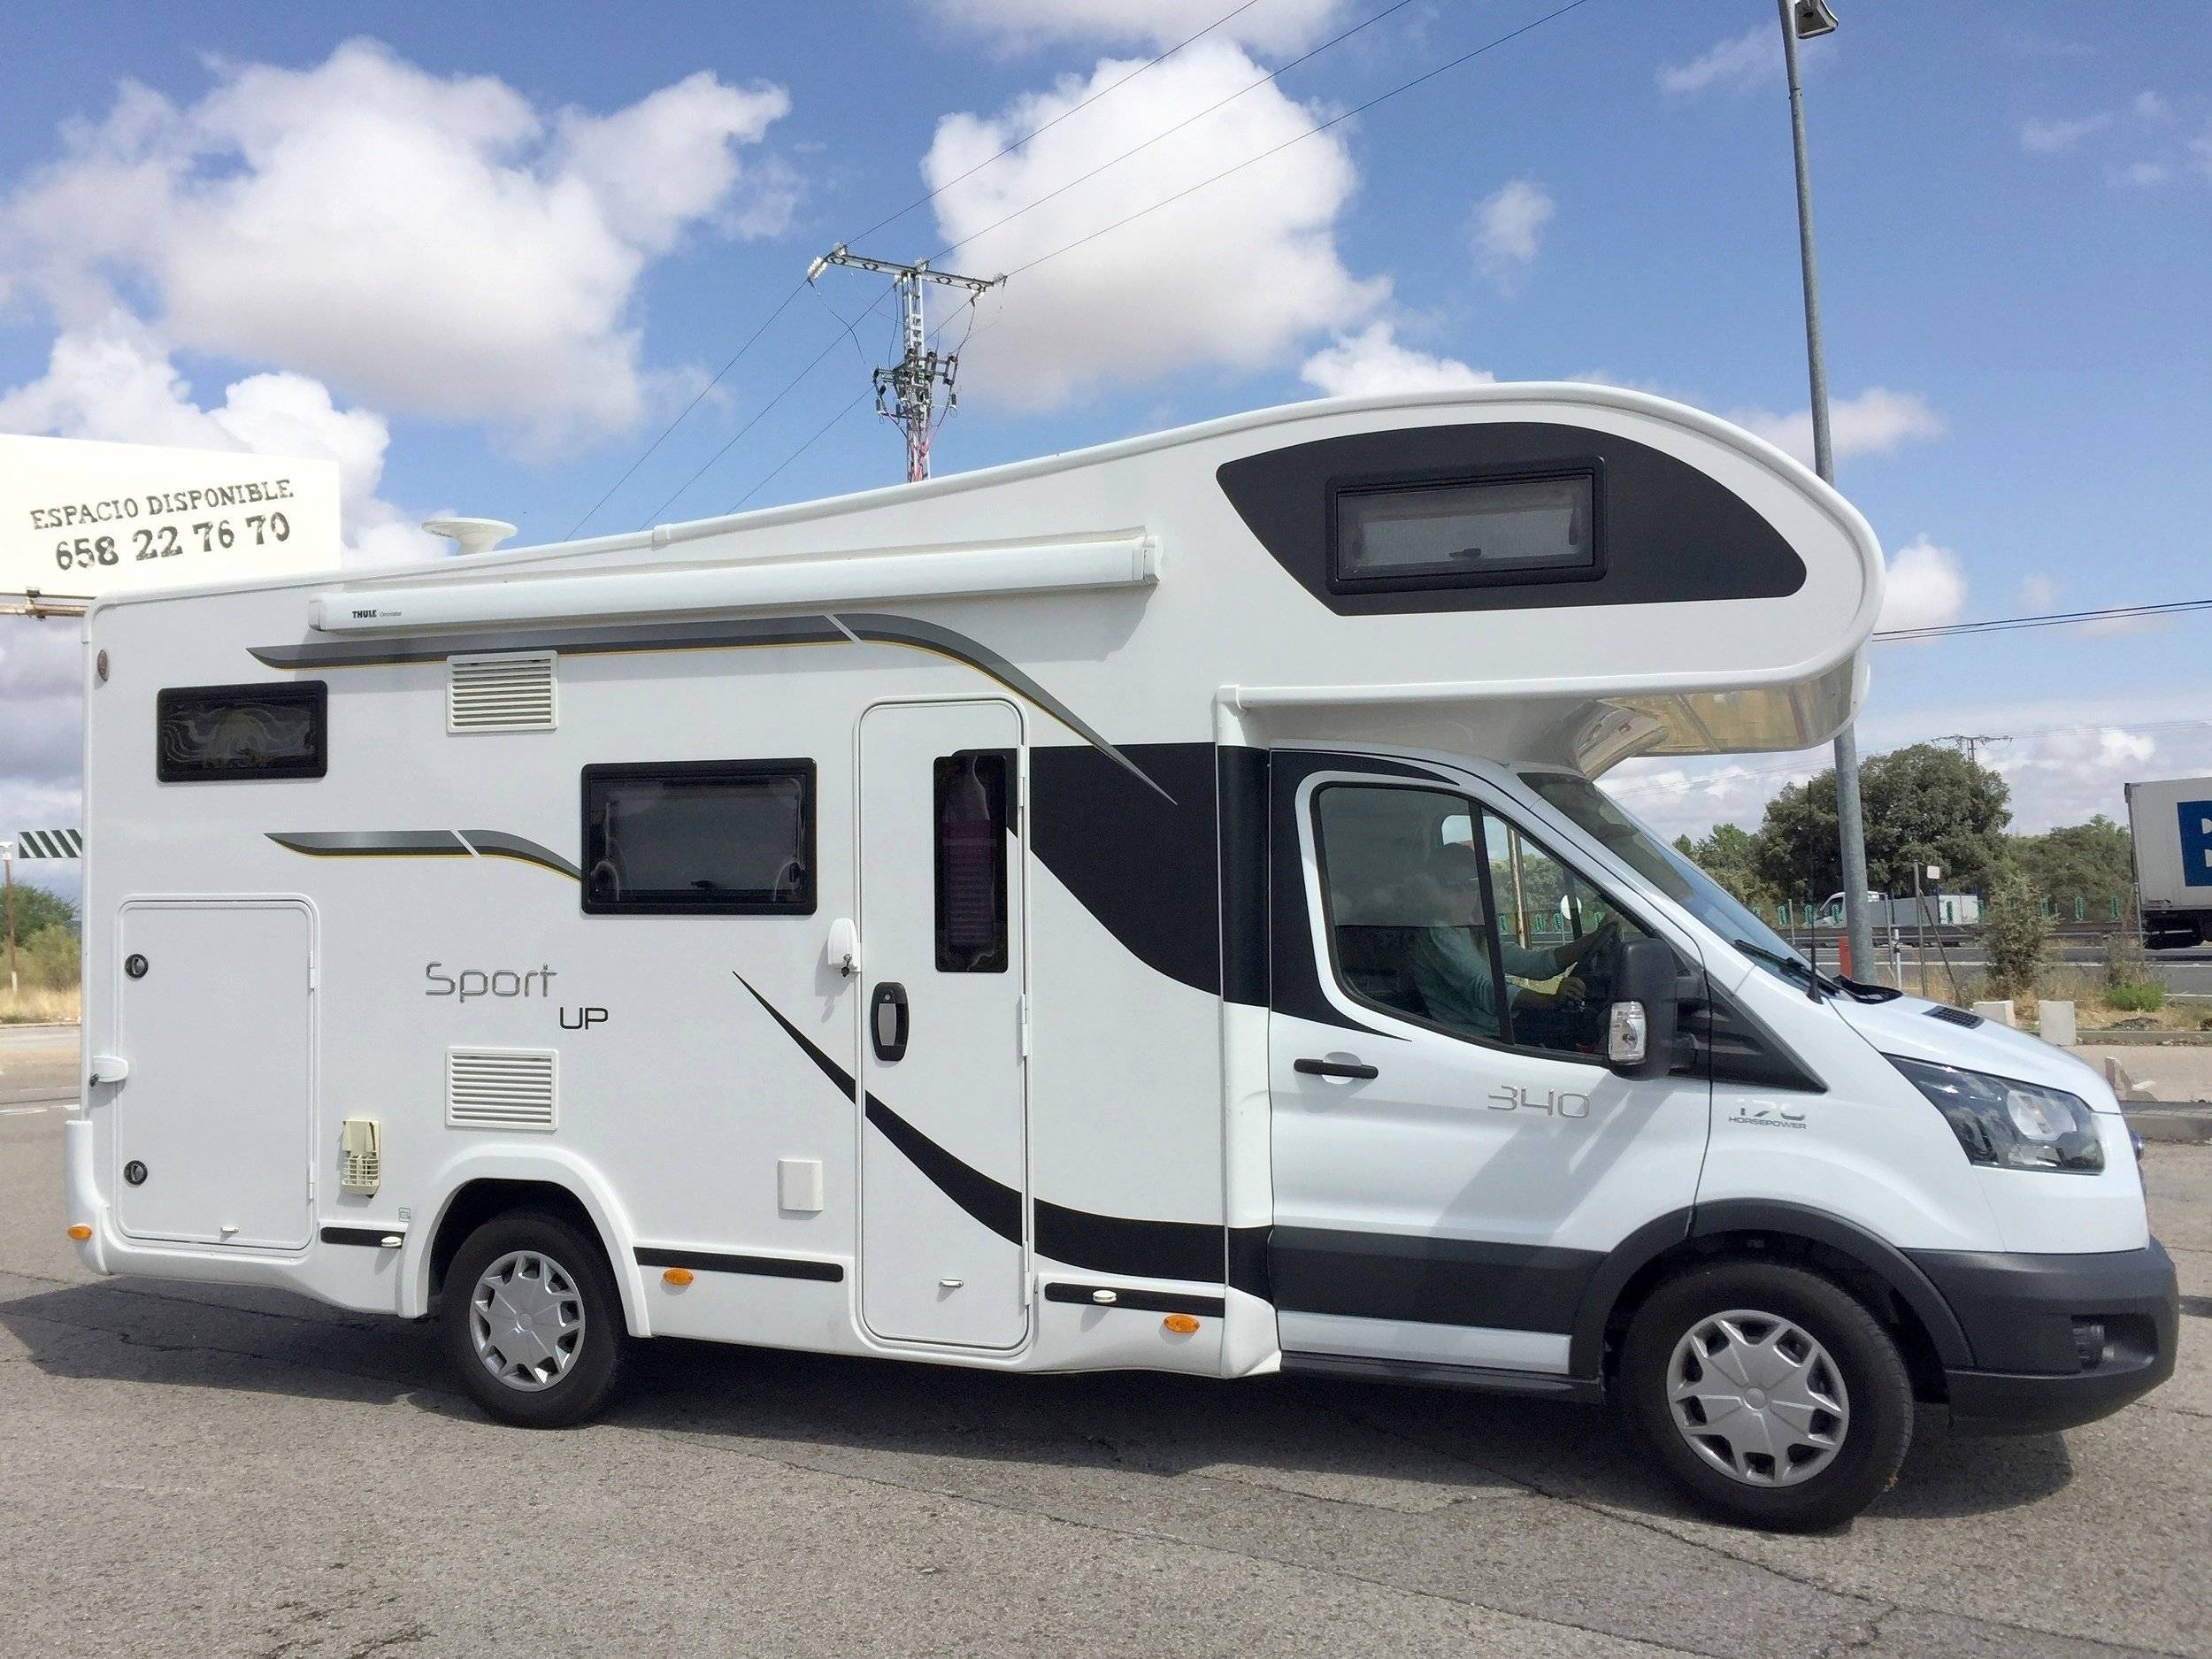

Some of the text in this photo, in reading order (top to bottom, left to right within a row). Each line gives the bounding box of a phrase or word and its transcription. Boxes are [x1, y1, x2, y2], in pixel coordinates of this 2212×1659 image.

[30, 479, 295, 531] ESPACIO DISPONIBLE
[56, 511, 291, 571] 658 22 76 70
[351, 609, 378, 618] THULE
[426, 961, 558, 1004] Sport
[559, 1006, 609, 1030] UP
[1487, 1085, 1591, 1119] 340
[1728, 1116, 1808, 1130] HORSEPOWER
